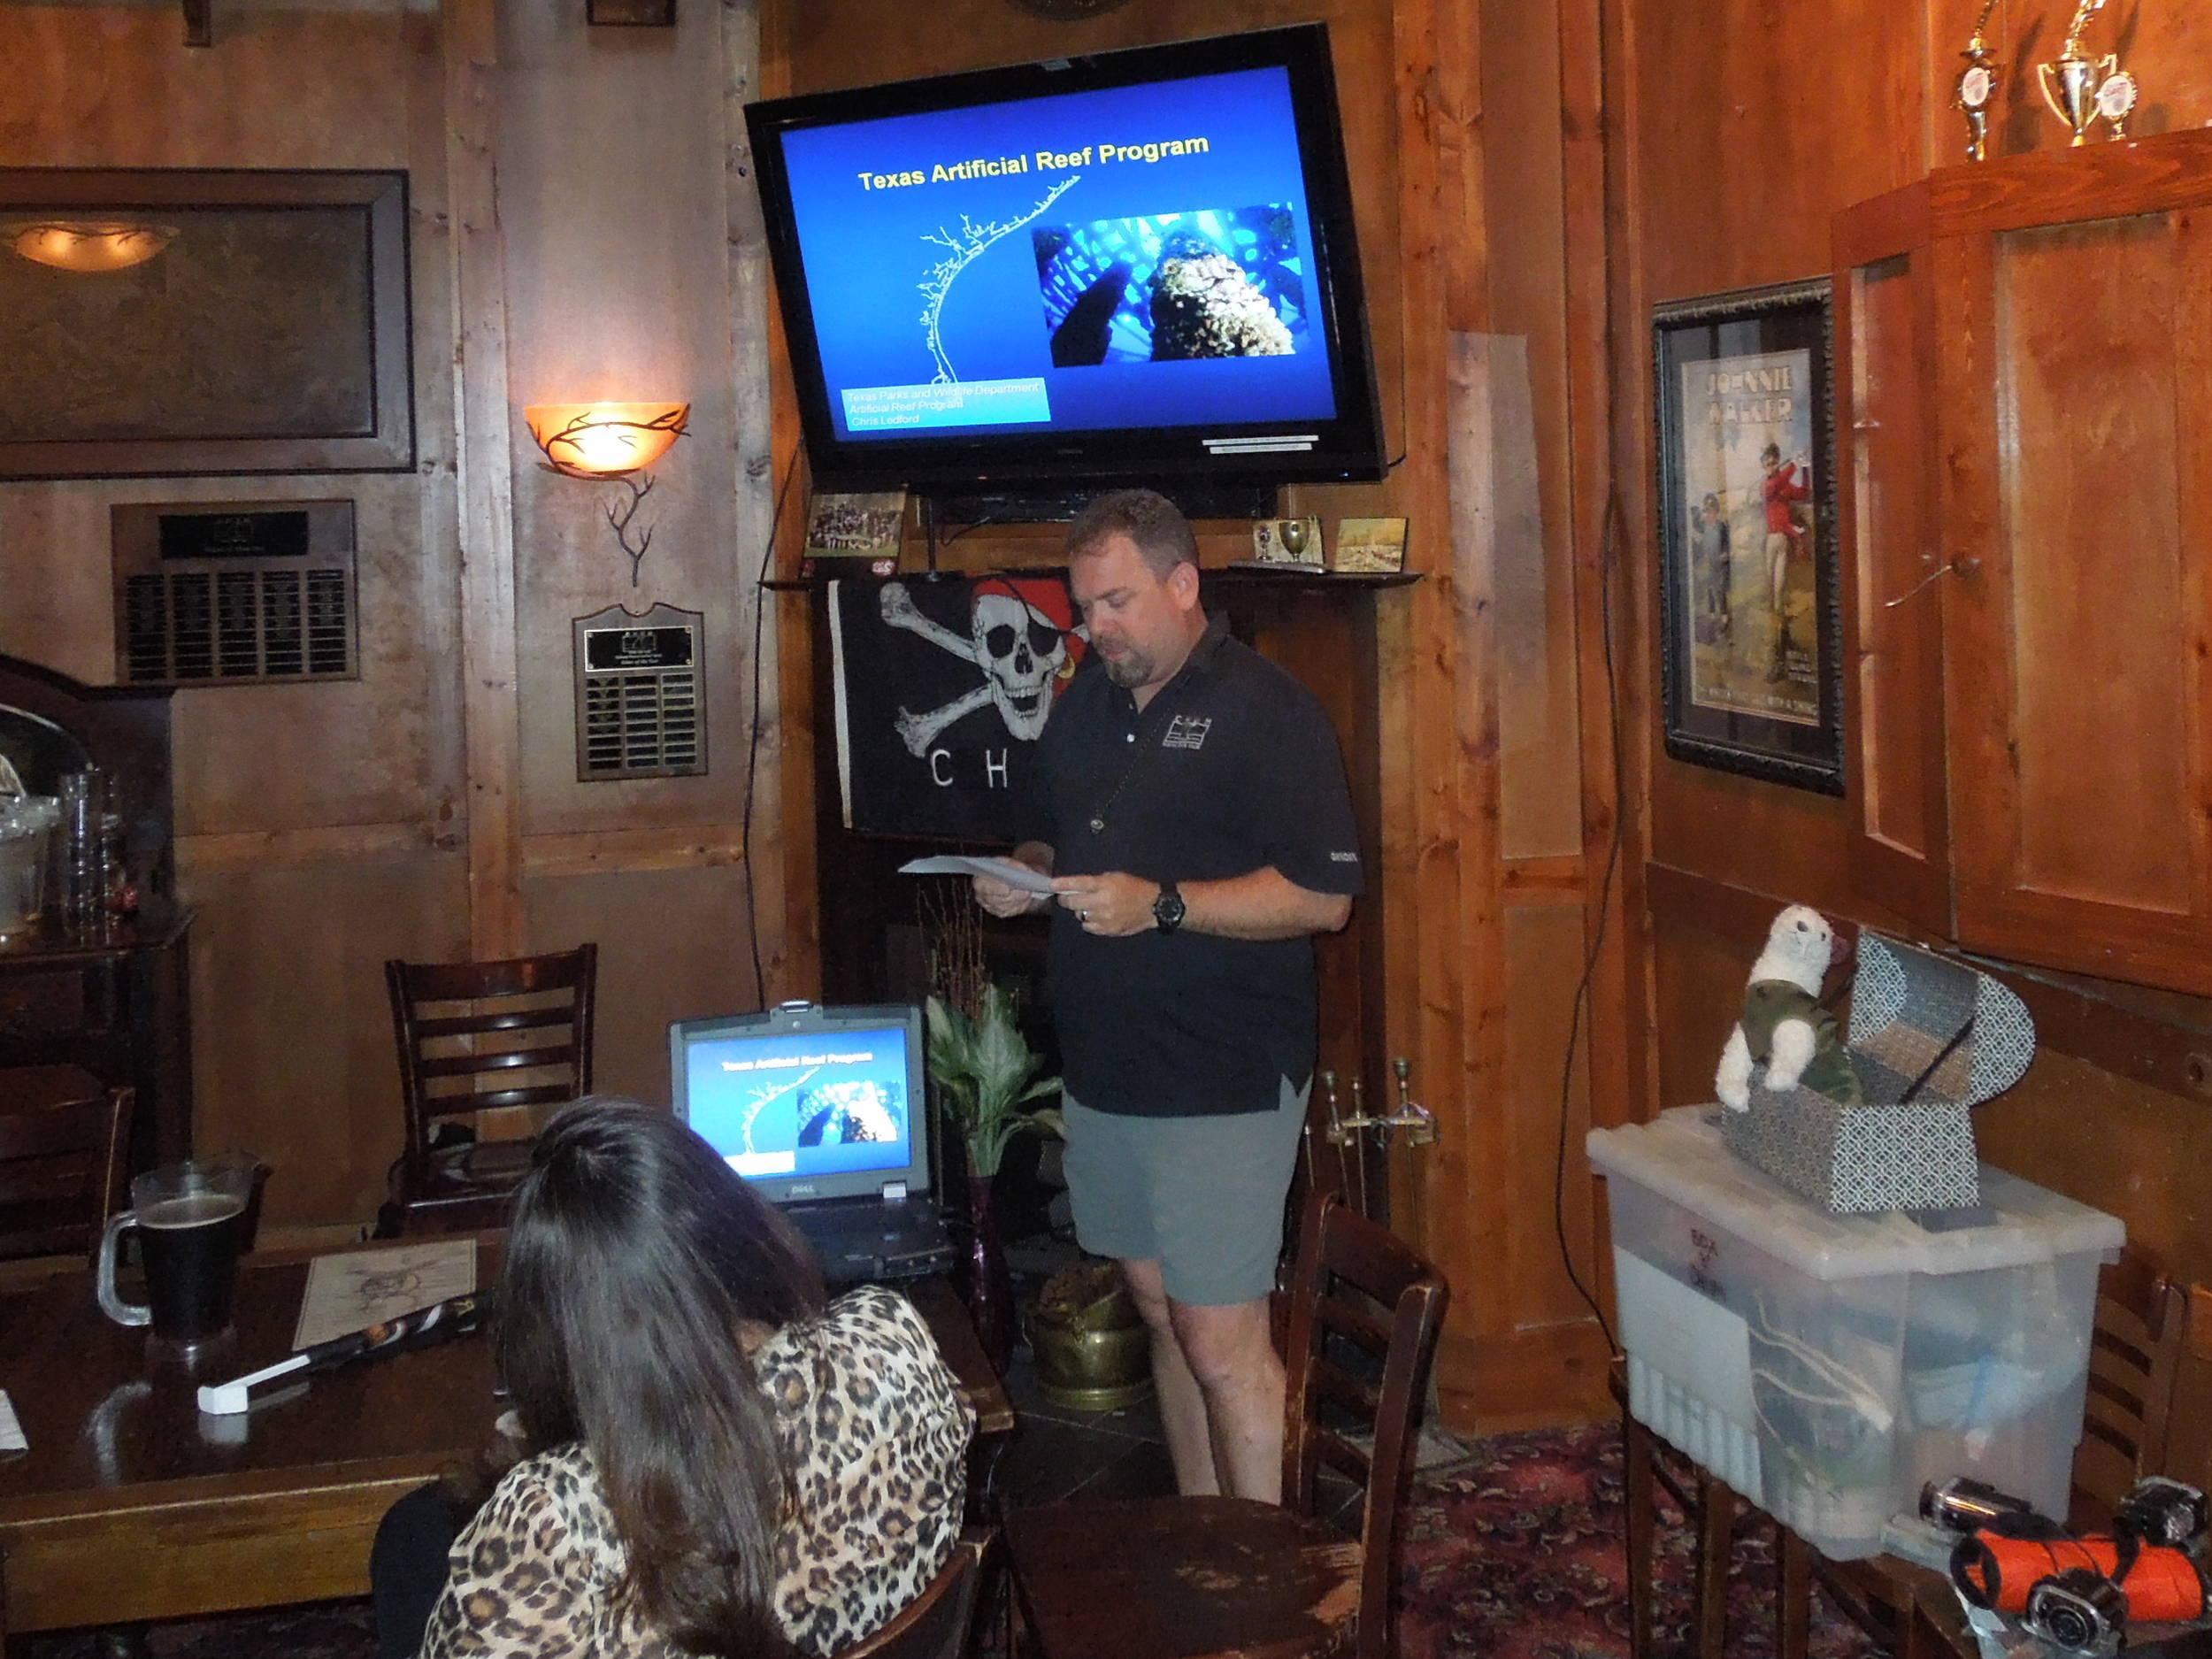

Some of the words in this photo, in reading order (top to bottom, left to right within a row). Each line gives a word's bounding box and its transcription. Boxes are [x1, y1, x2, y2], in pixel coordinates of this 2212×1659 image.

[857, 170, 926, 191] Texas
[931, 154, 1028, 183] Artificial
[1035, 147, 1092, 171] Reef
[1098, 136, 1210, 164] Program
[848, 392, 878, 403] Texas
[879, 389, 910, 400] Parks
[910, 388, 931, 398] and
[975, 382, 1041, 397] Department
[850, 402, 889, 413] Artificial
[891, 401, 917, 412] Reef
[918, 399, 964, 412] Program
[852, 416, 879, 426] Chris
